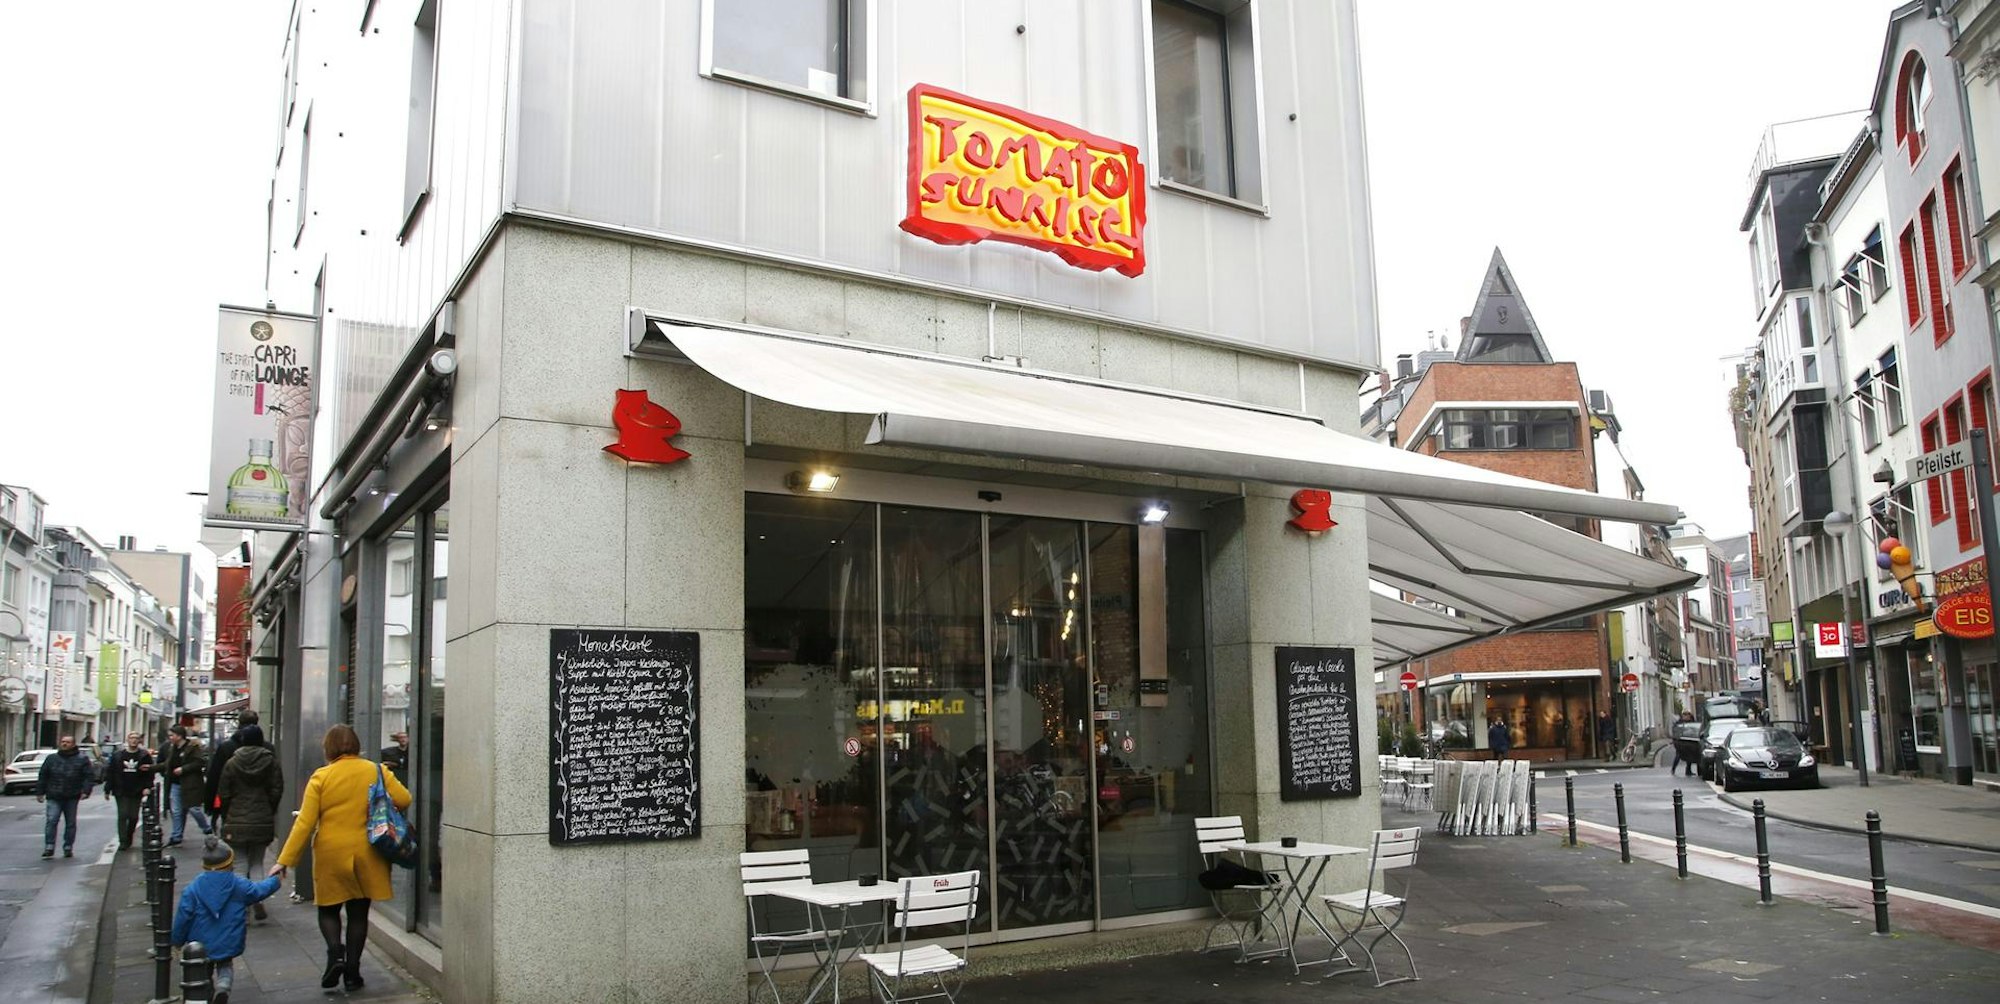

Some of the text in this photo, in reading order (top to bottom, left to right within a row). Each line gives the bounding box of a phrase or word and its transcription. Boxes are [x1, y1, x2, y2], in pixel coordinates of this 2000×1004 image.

[924, 113, 1129, 199] TOMATO
[220, 352, 255, 368] THE SPIRIT
[231, 369, 254, 382] OF FINE
[255, 363, 309, 387] LOUNGE
[229, 383, 253, 397] SPIRITS
[1916, 450, 1964, 478] Pfeilstr.
[1938, 597, 1965, 617] DOLCE
[1973, 596, 1991, 606] GEL
[1955, 608, 1990, 625] EIS
[578, 633, 653, 653] Monatskarte
[1822, 632, 1837, 642] 30
[592, 668, 605, 677] mit
[654, 682, 666, 691] mit
[933, 879, 950, 888] früh
